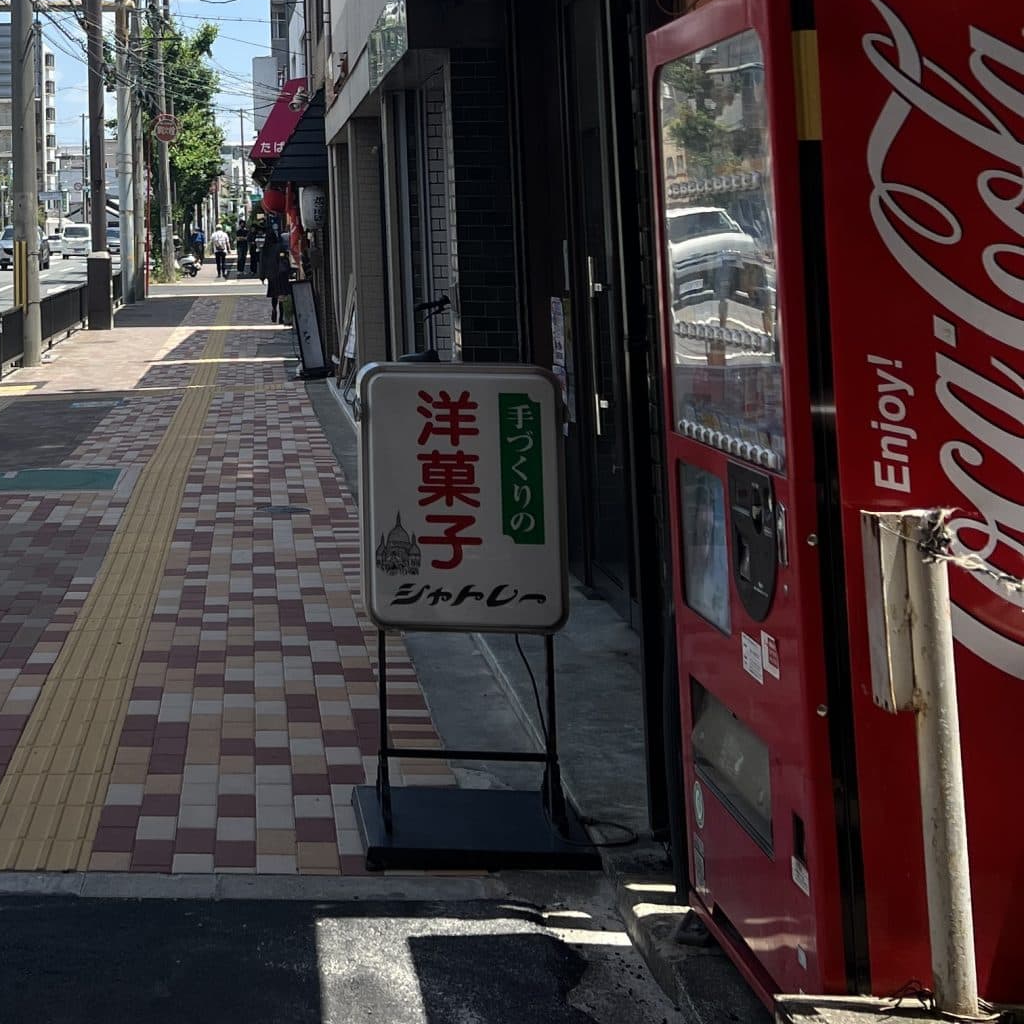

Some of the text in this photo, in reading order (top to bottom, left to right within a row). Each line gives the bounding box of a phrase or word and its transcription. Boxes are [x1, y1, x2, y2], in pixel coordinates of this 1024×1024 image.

[416, 390, 483, 570] 洋菓子
[506, 404, 535, 533] 手づくりの
[867, 354, 918, 494] Enjoy!
